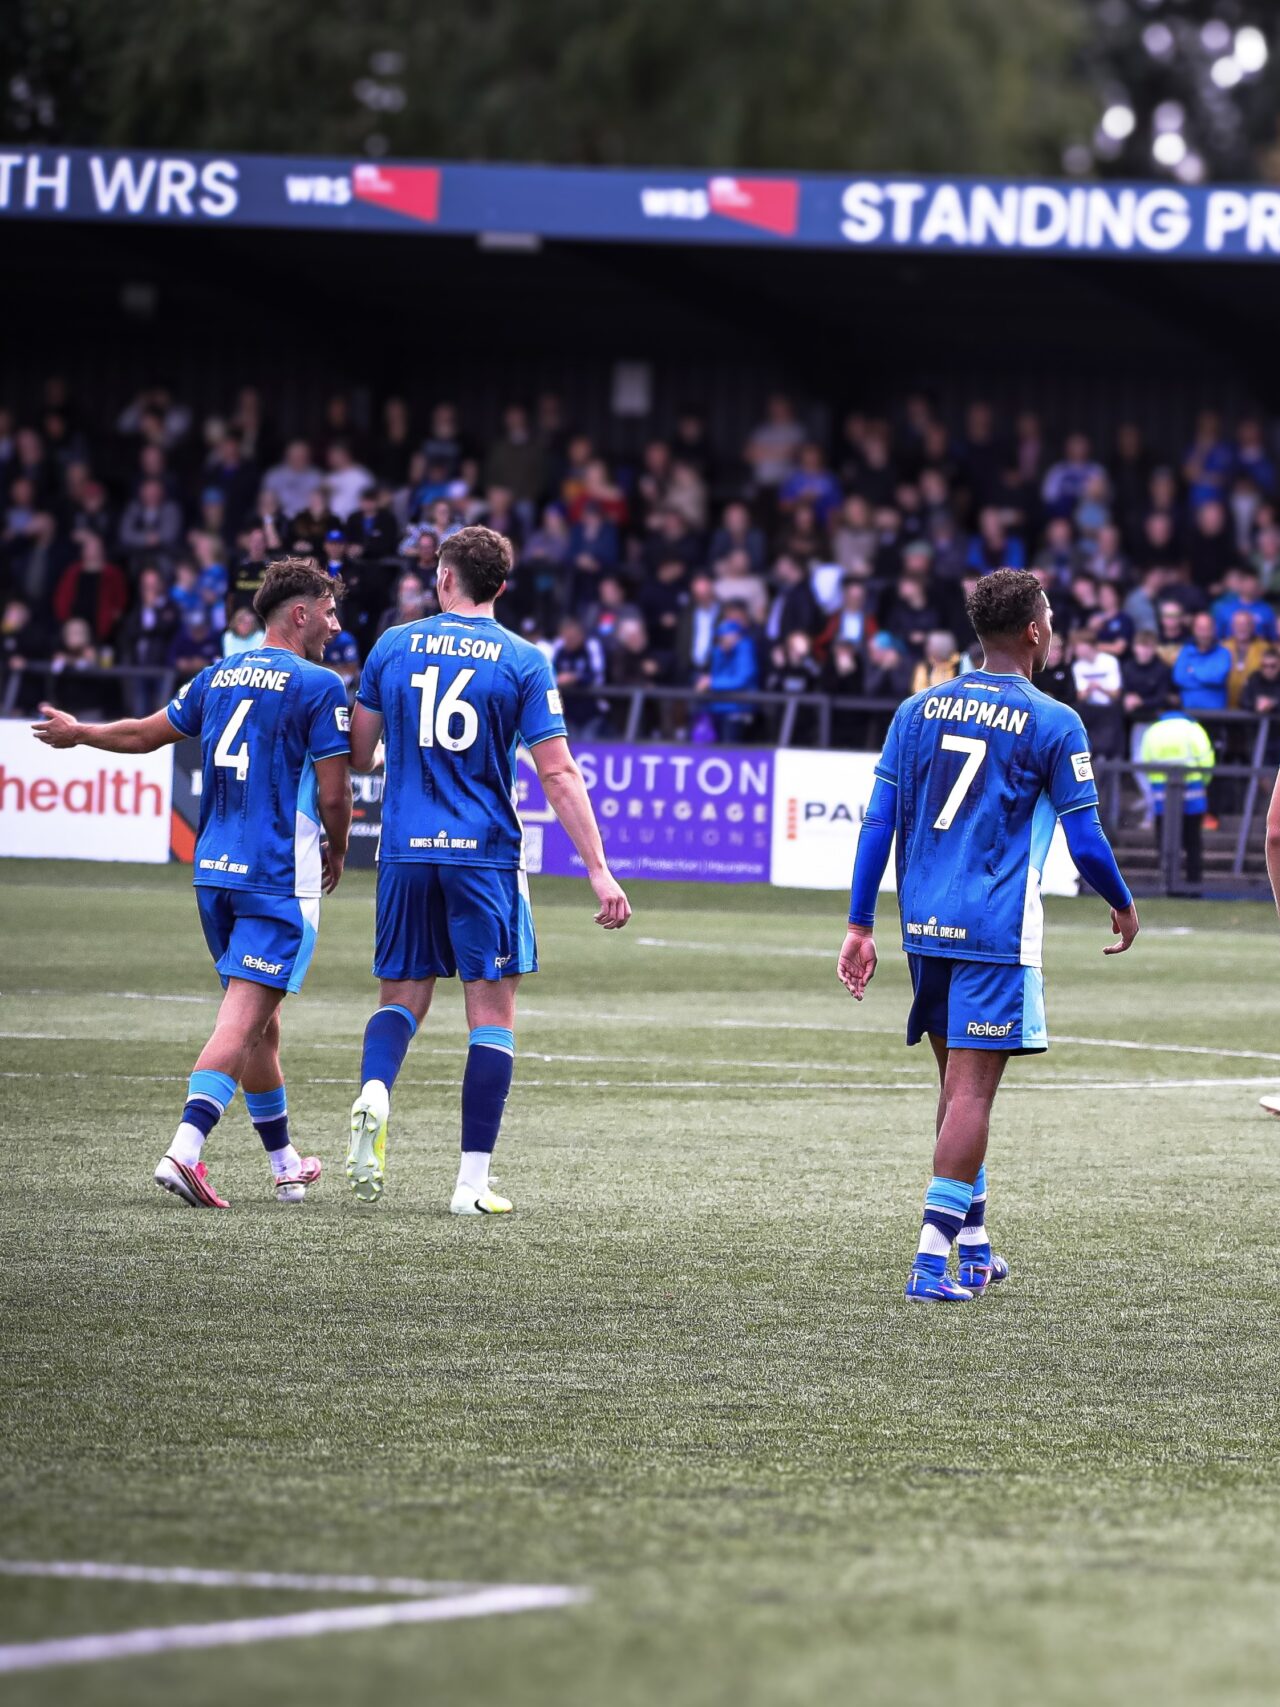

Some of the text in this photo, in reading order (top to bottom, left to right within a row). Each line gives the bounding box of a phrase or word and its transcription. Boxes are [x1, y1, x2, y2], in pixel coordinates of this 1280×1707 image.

[91, 158, 239, 215] WRS
[285, 175, 351, 205] WRS
[640, 188, 709, 219] WRS
[841, 182, 1191, 250] STANDING
[410, 634, 502, 662] T.WILSON
[211, 667, 290, 692] OSBORNE
[411, 666, 478, 752] 16
[923, 696, 1029, 735] CHAPMAN
[214, 700, 254, 780] 4
[575, 752, 768, 795] SUTTON
[933, 735, 987, 830] 7
[0, 764, 163, 816] health
[601, 798, 767, 823] ORTGAGE
[410, 837, 478, 850] KINGS WILL DREAM
[601, 822, 767, 848] LUTIONS
[922, 924, 938, 937] WILL
[940, 926, 966, 940] DREAM
[241, 954, 284, 976] Releaf
[966, 1022, 1012, 1037] Releaf
